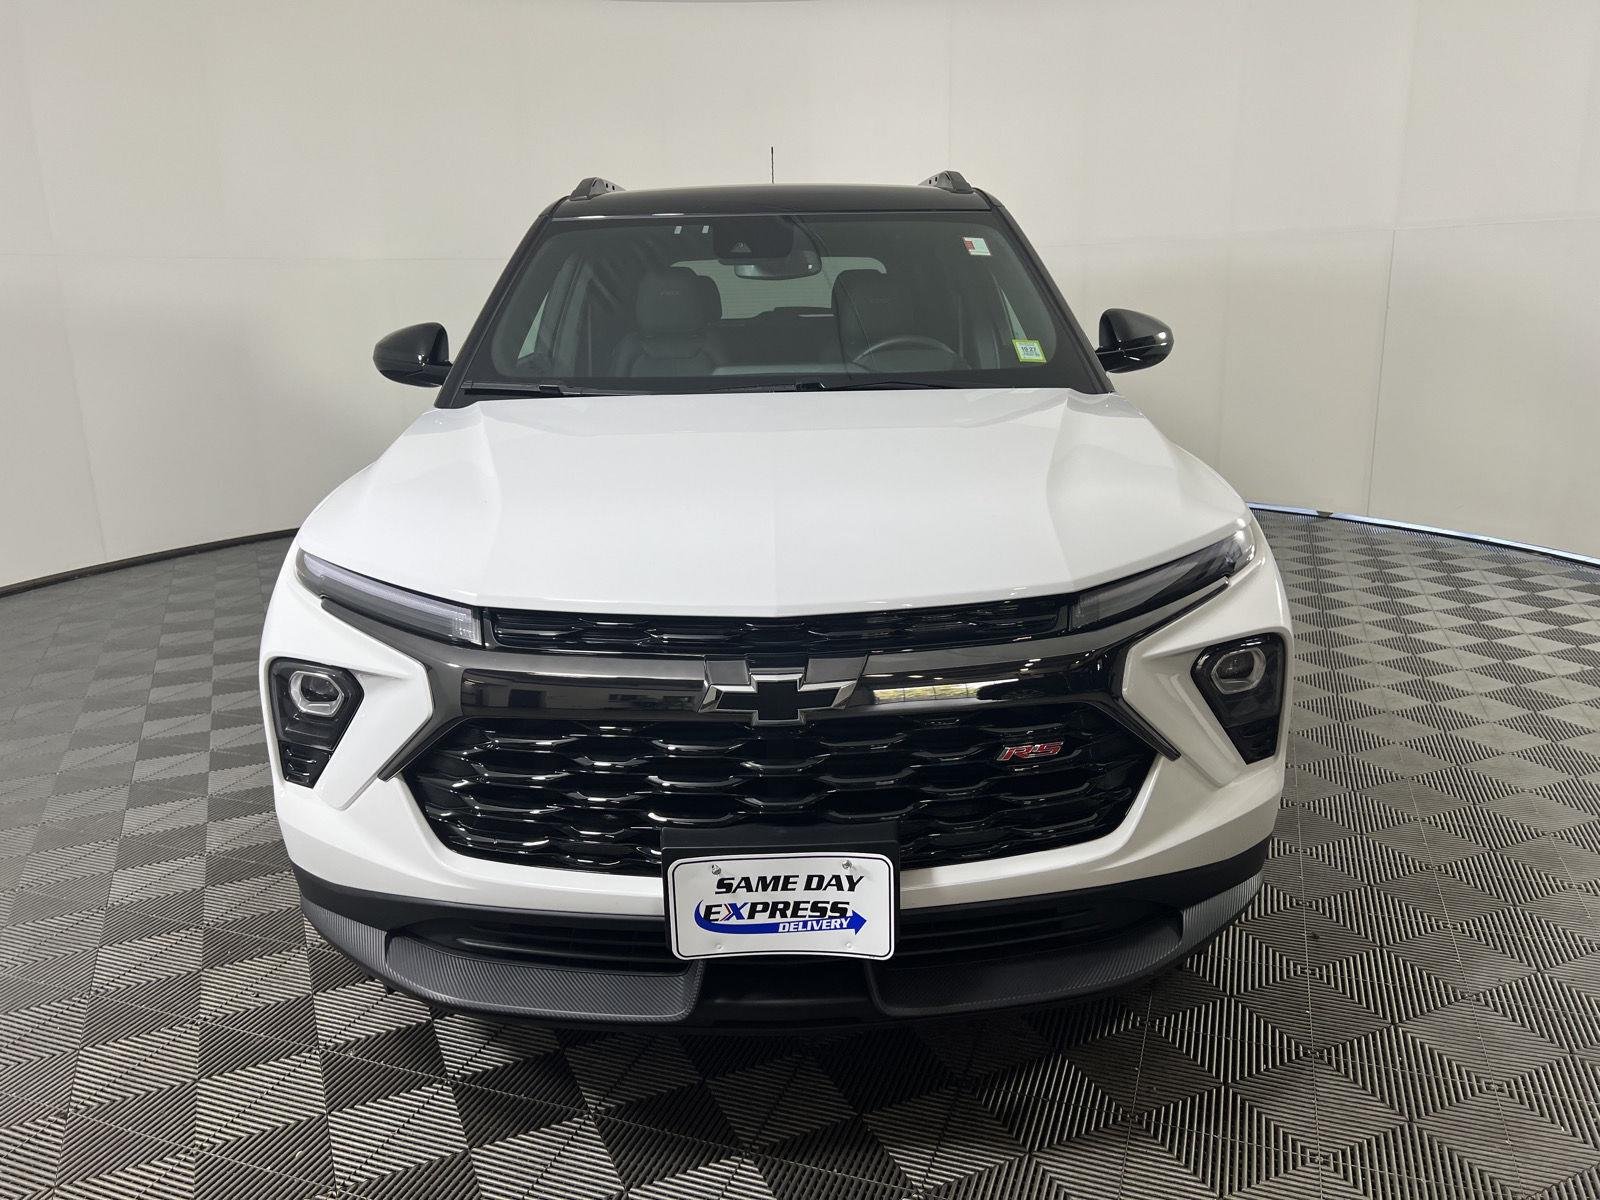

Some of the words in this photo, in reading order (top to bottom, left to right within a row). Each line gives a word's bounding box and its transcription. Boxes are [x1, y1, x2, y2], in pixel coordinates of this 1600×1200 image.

[997, 742, 1063, 761] RS
[715, 874, 799, 894] SAME
[804, 874, 864, 892] DAY
[703, 901, 849, 922] EXPRESS
[778, 917, 851, 933] DELIVERY
